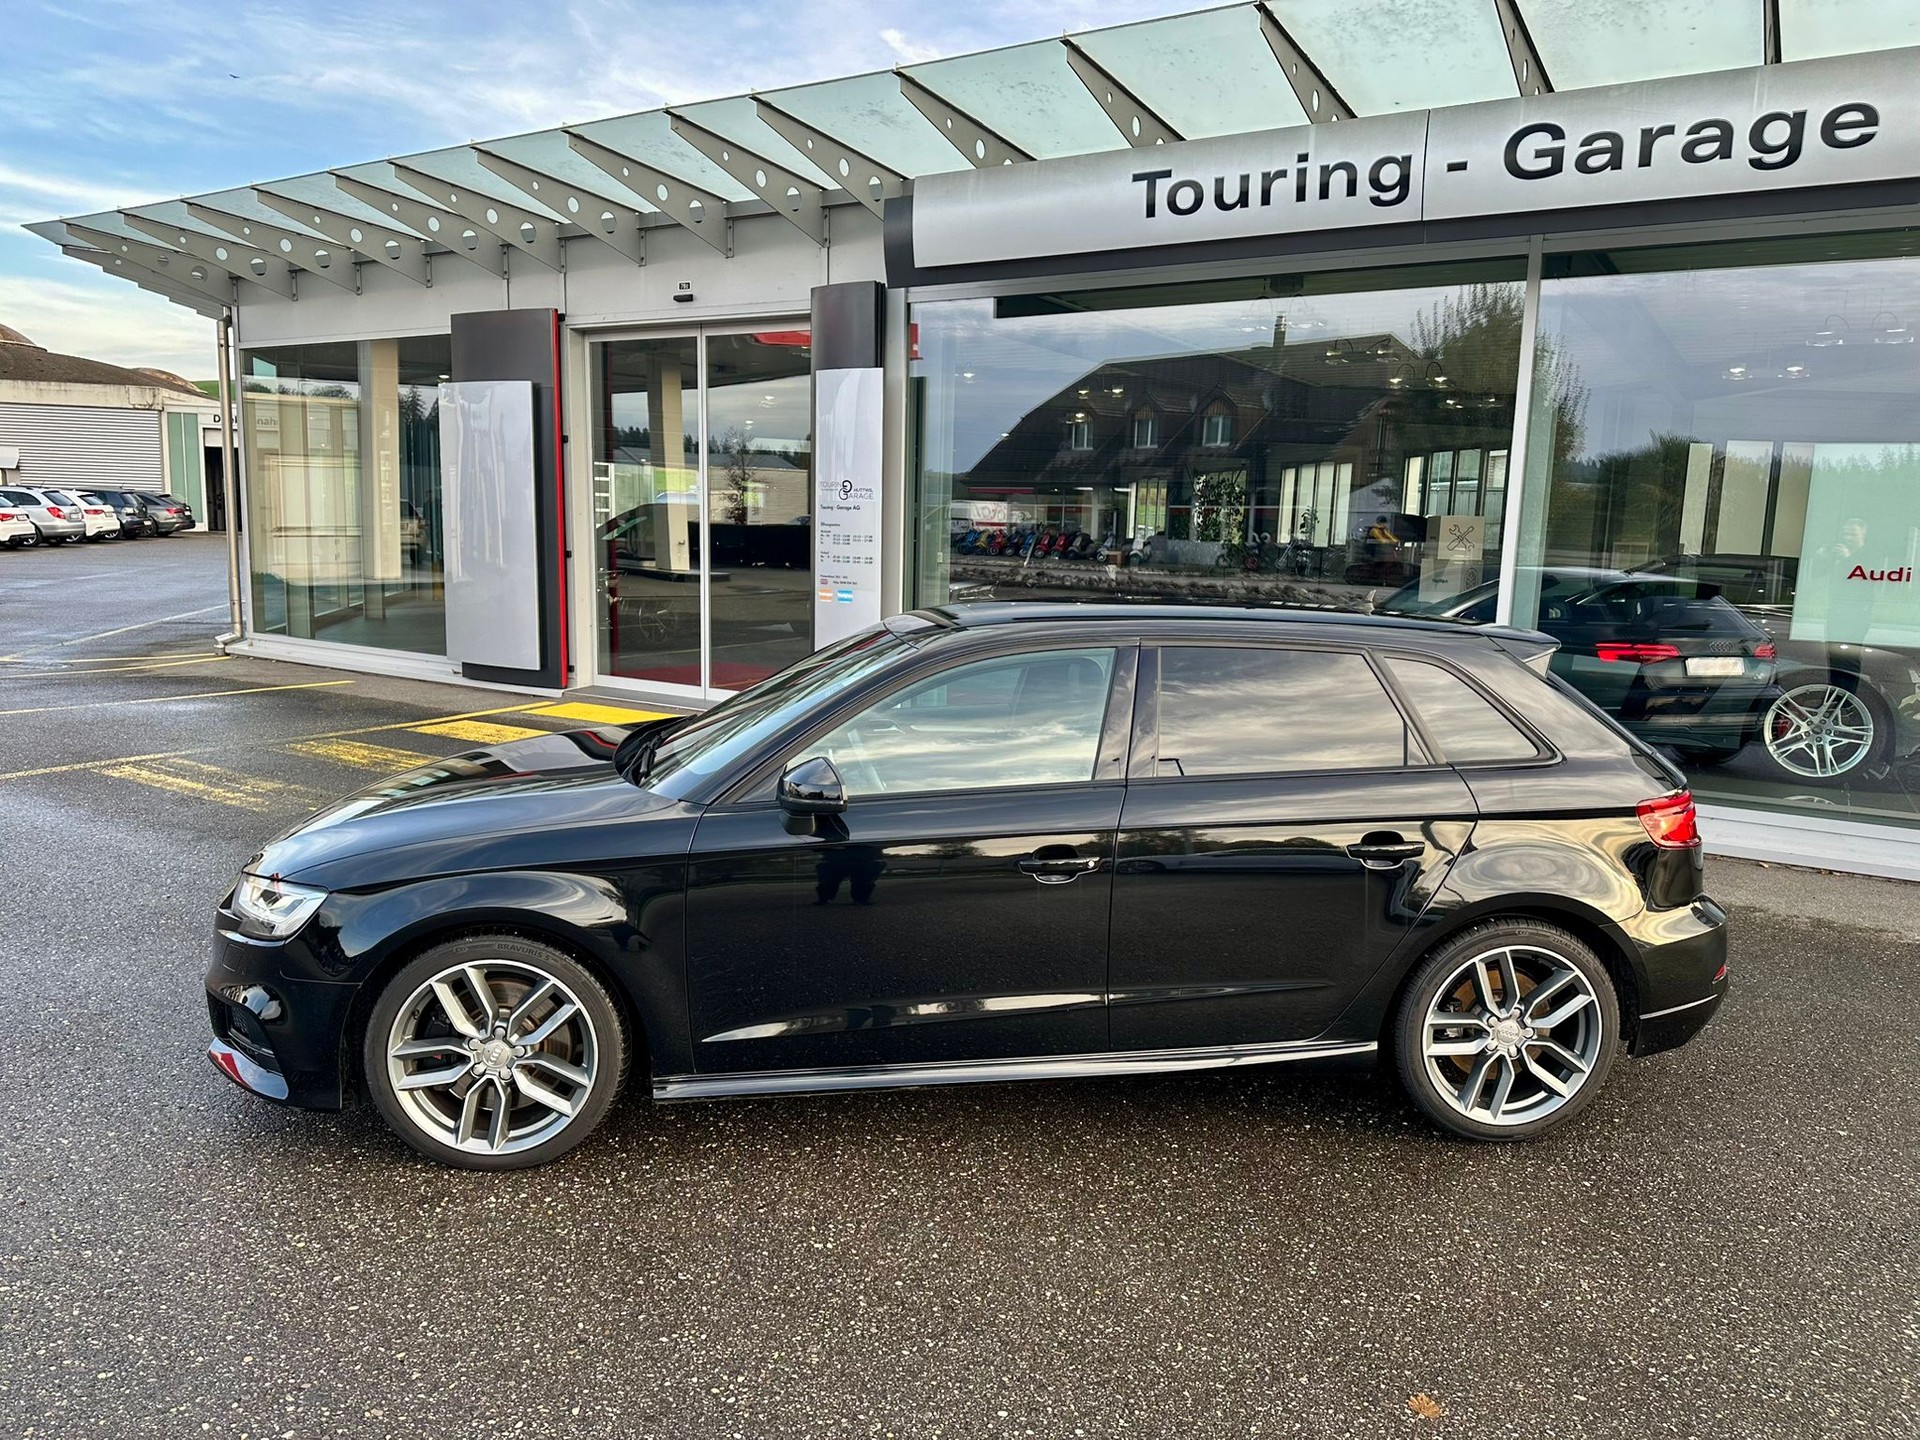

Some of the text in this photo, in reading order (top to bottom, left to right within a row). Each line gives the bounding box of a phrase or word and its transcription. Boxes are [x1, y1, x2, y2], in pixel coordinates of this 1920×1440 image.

[1132, 101, 1881, 219] Touring - Garage
[1847, 565, 1912, 582] Audi
[497, 944, 544, 958] BRAVURIS
